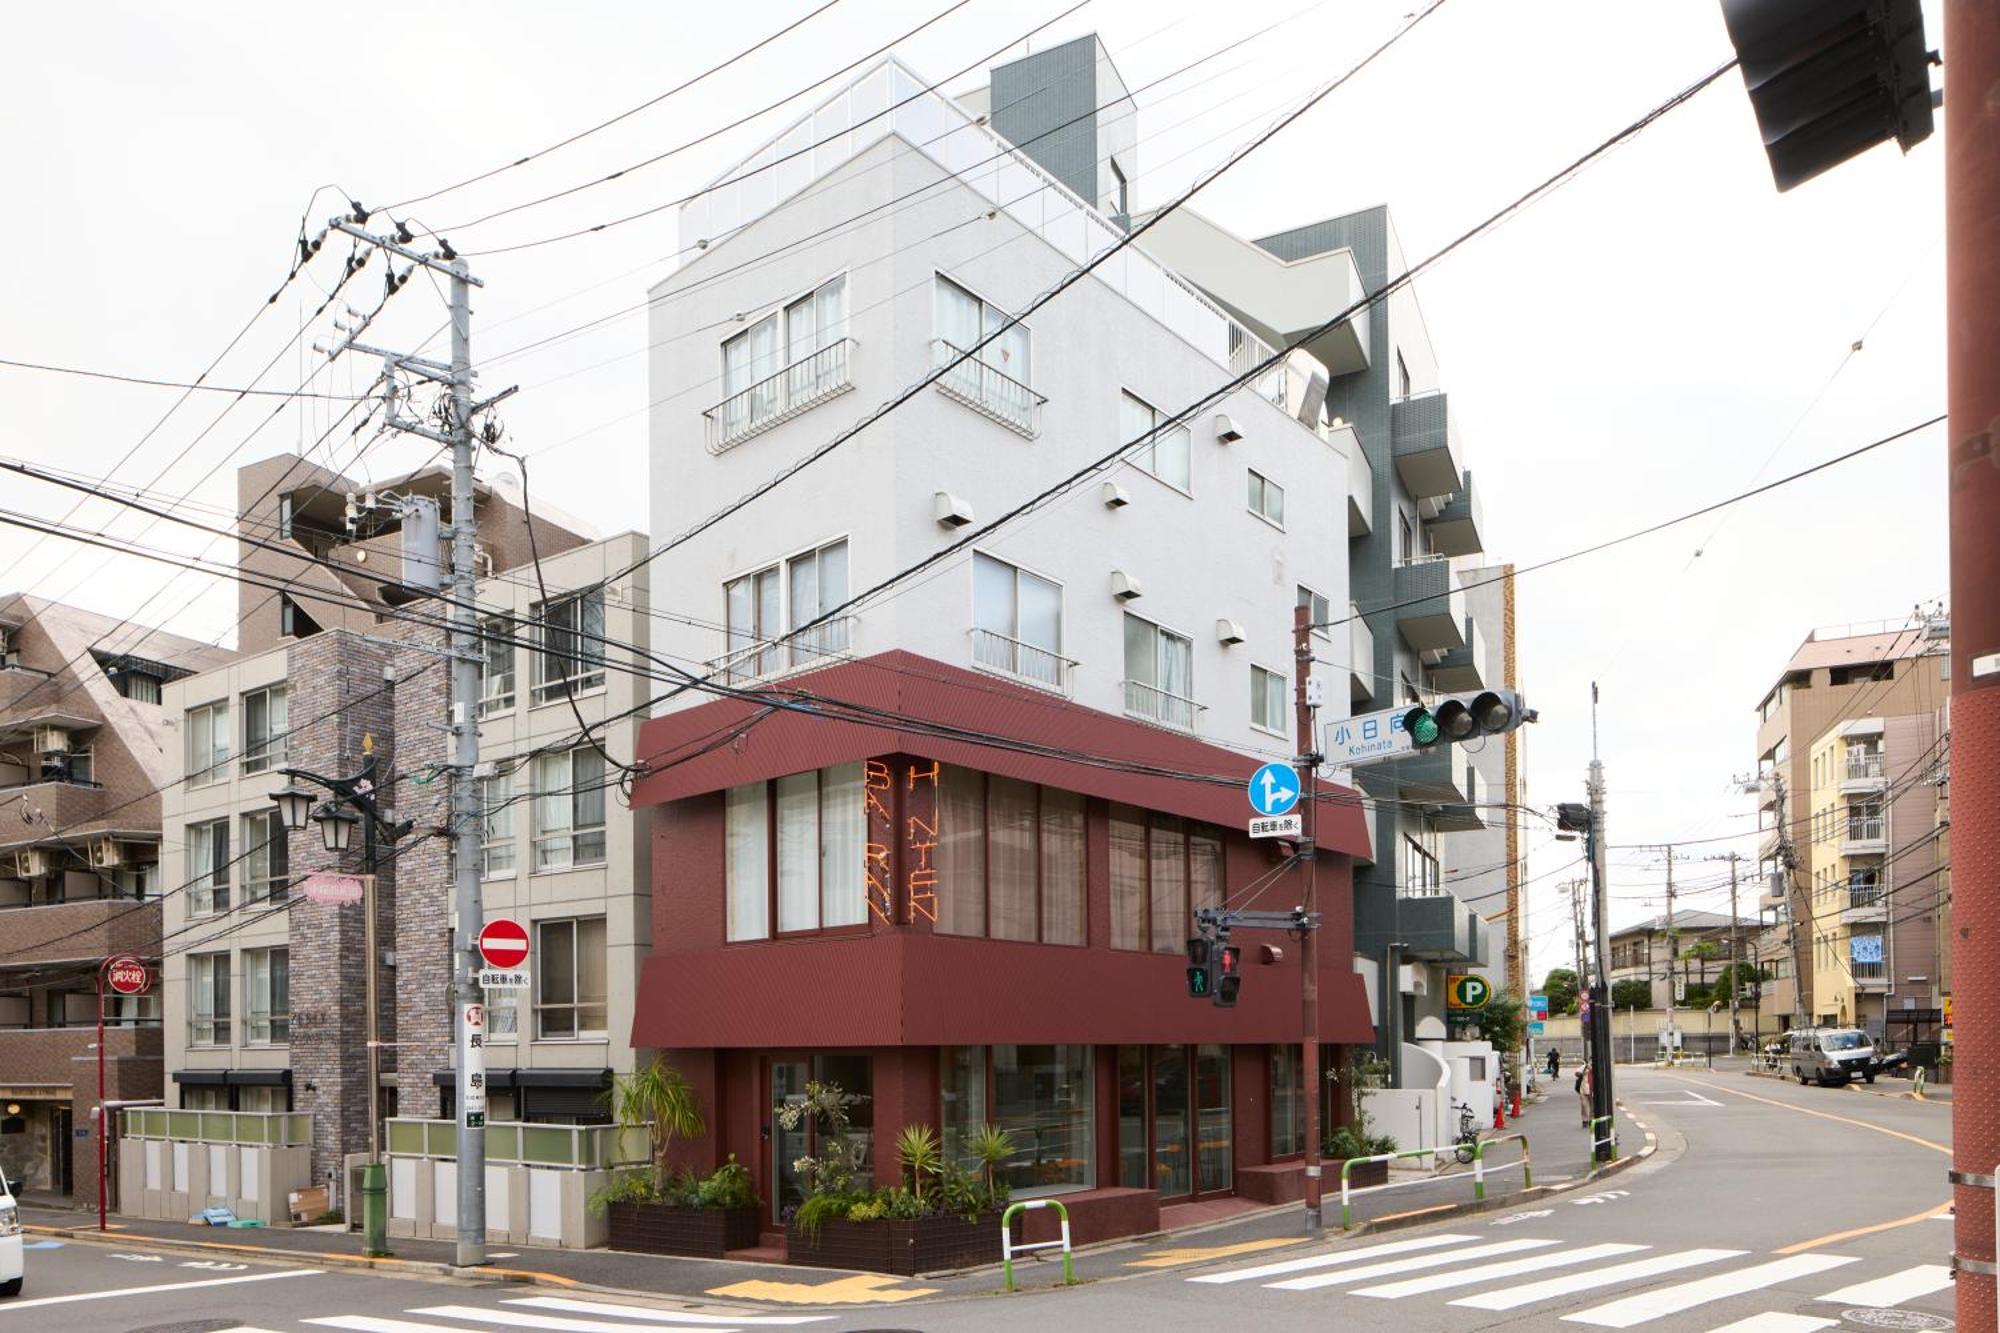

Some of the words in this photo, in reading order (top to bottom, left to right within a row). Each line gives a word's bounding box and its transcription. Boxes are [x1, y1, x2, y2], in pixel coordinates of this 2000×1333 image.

[1335, 713, 1404, 746] 小日向
[1349, 739, 1393, 757] Kohinata
[1252, 819, 1299, 834] 自転車を除く
[112, 969, 143, 984] 消火栓
[482, 973, 529, 985] 自転車を除く
[1465, 981, 1484, 1003] P
[470, 1033, 484, 1090] 長島
